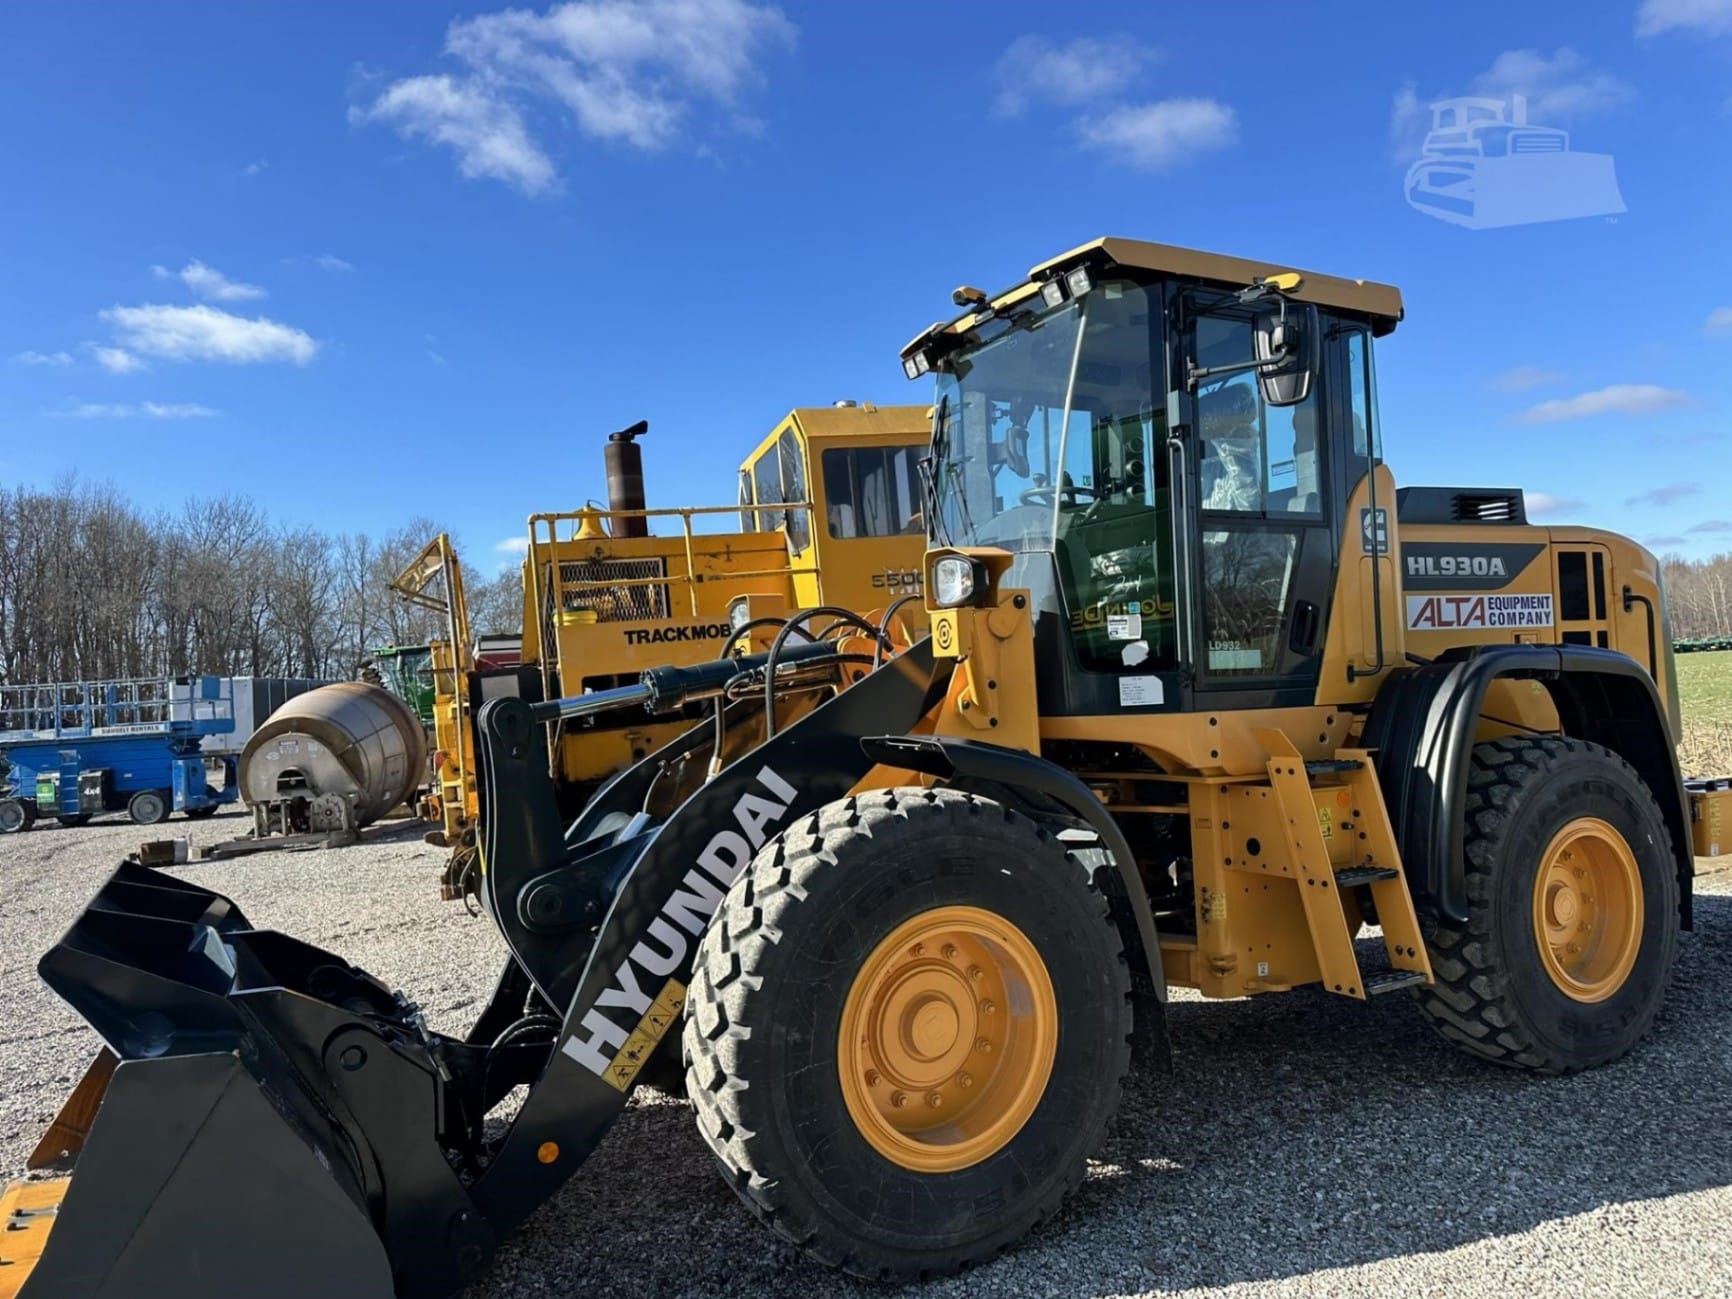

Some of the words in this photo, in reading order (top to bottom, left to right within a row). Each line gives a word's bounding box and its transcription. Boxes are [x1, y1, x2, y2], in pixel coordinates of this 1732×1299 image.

[1407, 556, 1507, 577] HL930A
[1411, 597, 1487, 628] ALTA
[1488, 595, 1551, 611] EQUIPMENT
[1488, 611, 1552, 626] COMPANY
[561, 765, 798, 1077] HYUNDAI
